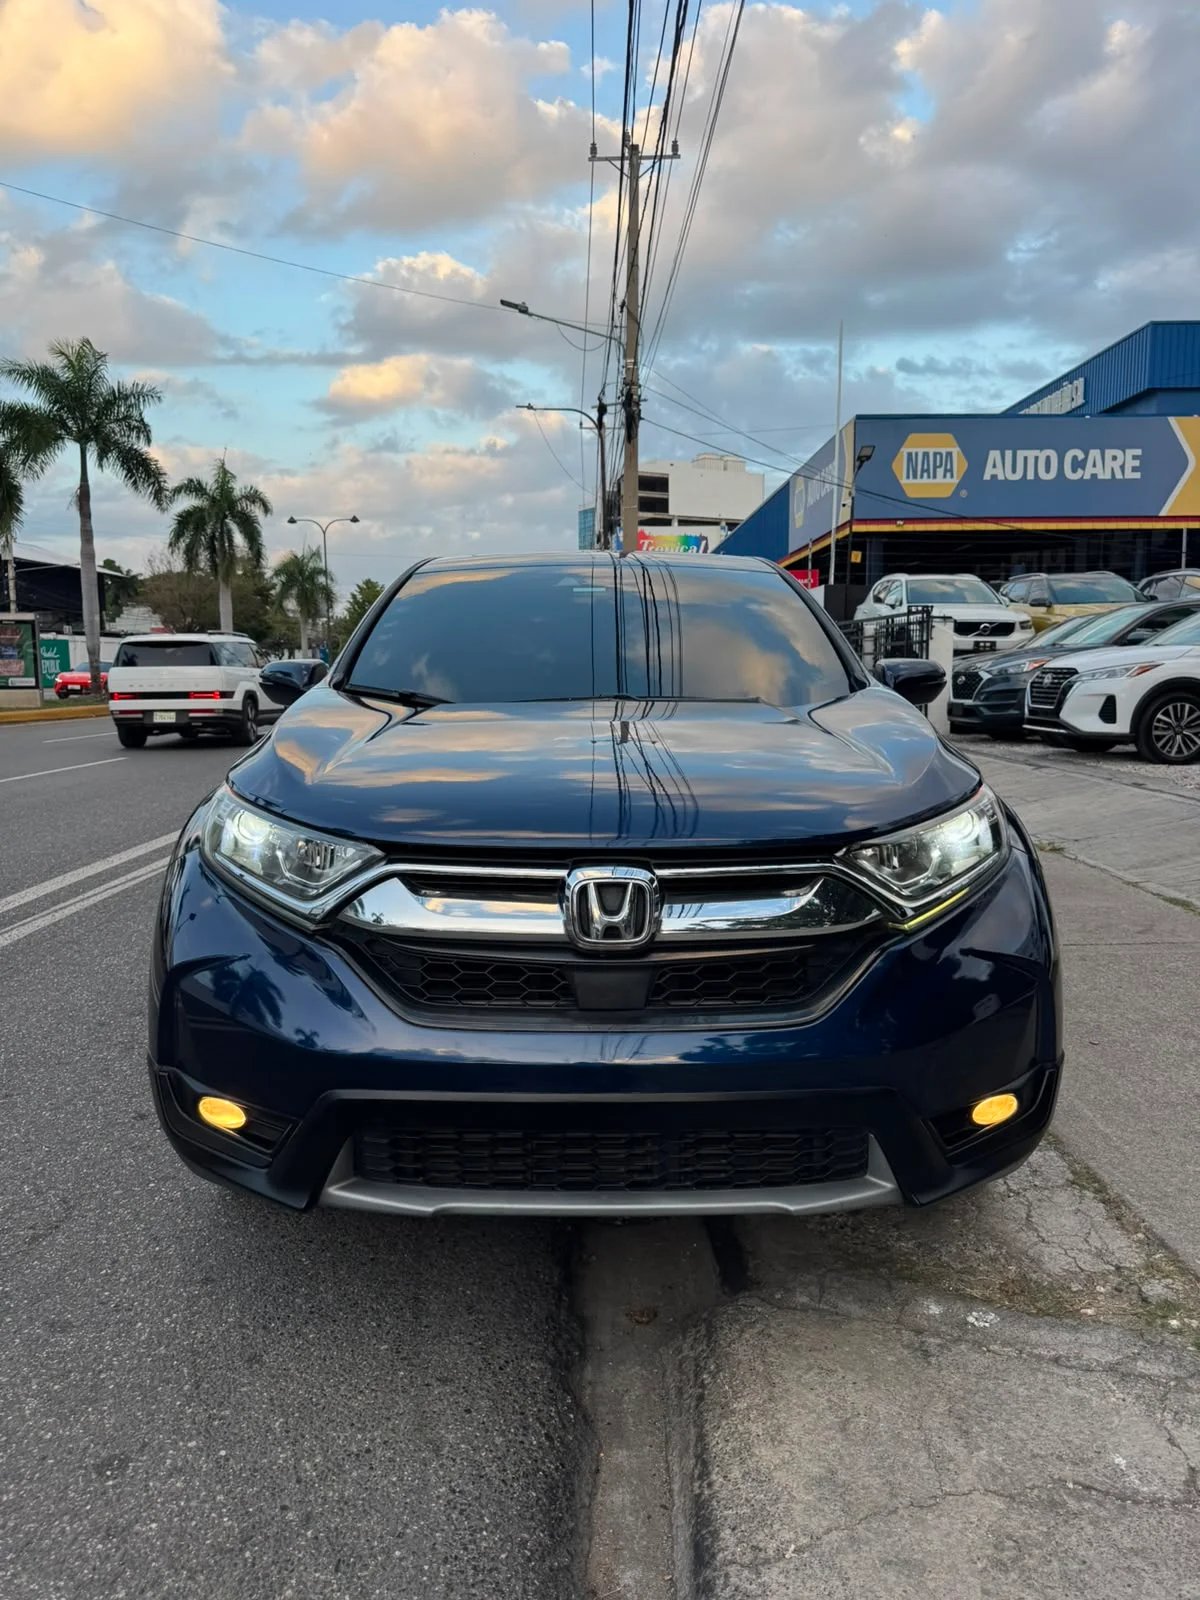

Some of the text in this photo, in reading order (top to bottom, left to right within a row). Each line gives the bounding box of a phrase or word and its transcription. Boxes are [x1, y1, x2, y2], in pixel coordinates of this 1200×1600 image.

[905, 451, 955, 480] NAPA
[983, 448, 1142, 481] AUTO CARE
